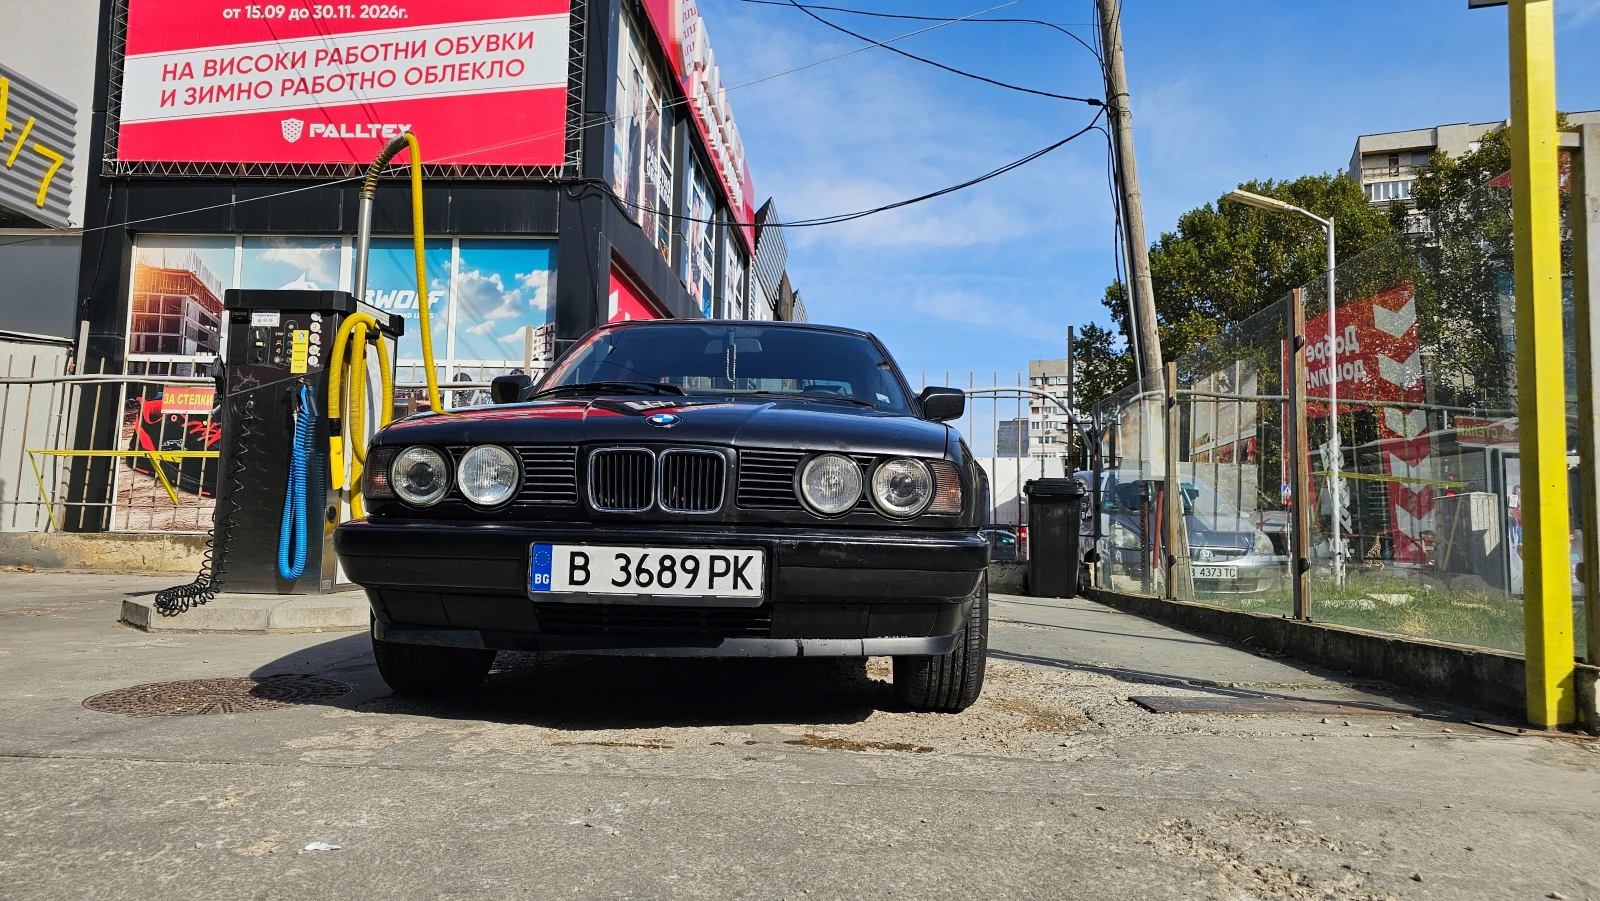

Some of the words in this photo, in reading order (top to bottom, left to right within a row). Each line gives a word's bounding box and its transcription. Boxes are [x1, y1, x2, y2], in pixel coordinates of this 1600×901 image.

[222, 8, 241, 19] от
[245, 5, 285, 19] 15.09
[288, 8, 310, 21] до
[312, 5, 355, 19] 30.11.
[359, 5, 408, 19] 2026г.
[161, 61, 195, 82] НА
[203, 50, 307, 78] ВИСОКИ
[314, 39, 427, 68] РАБОТНИ
[434, 31, 535, 57] ОБУВКИ
[159, 88, 177, 108] И
[183, 80, 273, 106] ЗИМНО
[280, 69, 397, 97] РАБОТНО
[404, 58, 525, 86] ОБЛЕКЛО
[309, 123, 412, 139] PALLTEX
[164, 393, 175, 405] ЗА
[177, 393, 214, 405] СТЕЛКИ
[568, 551, 591, 586] B
[534, 573, 550, 585] BG
